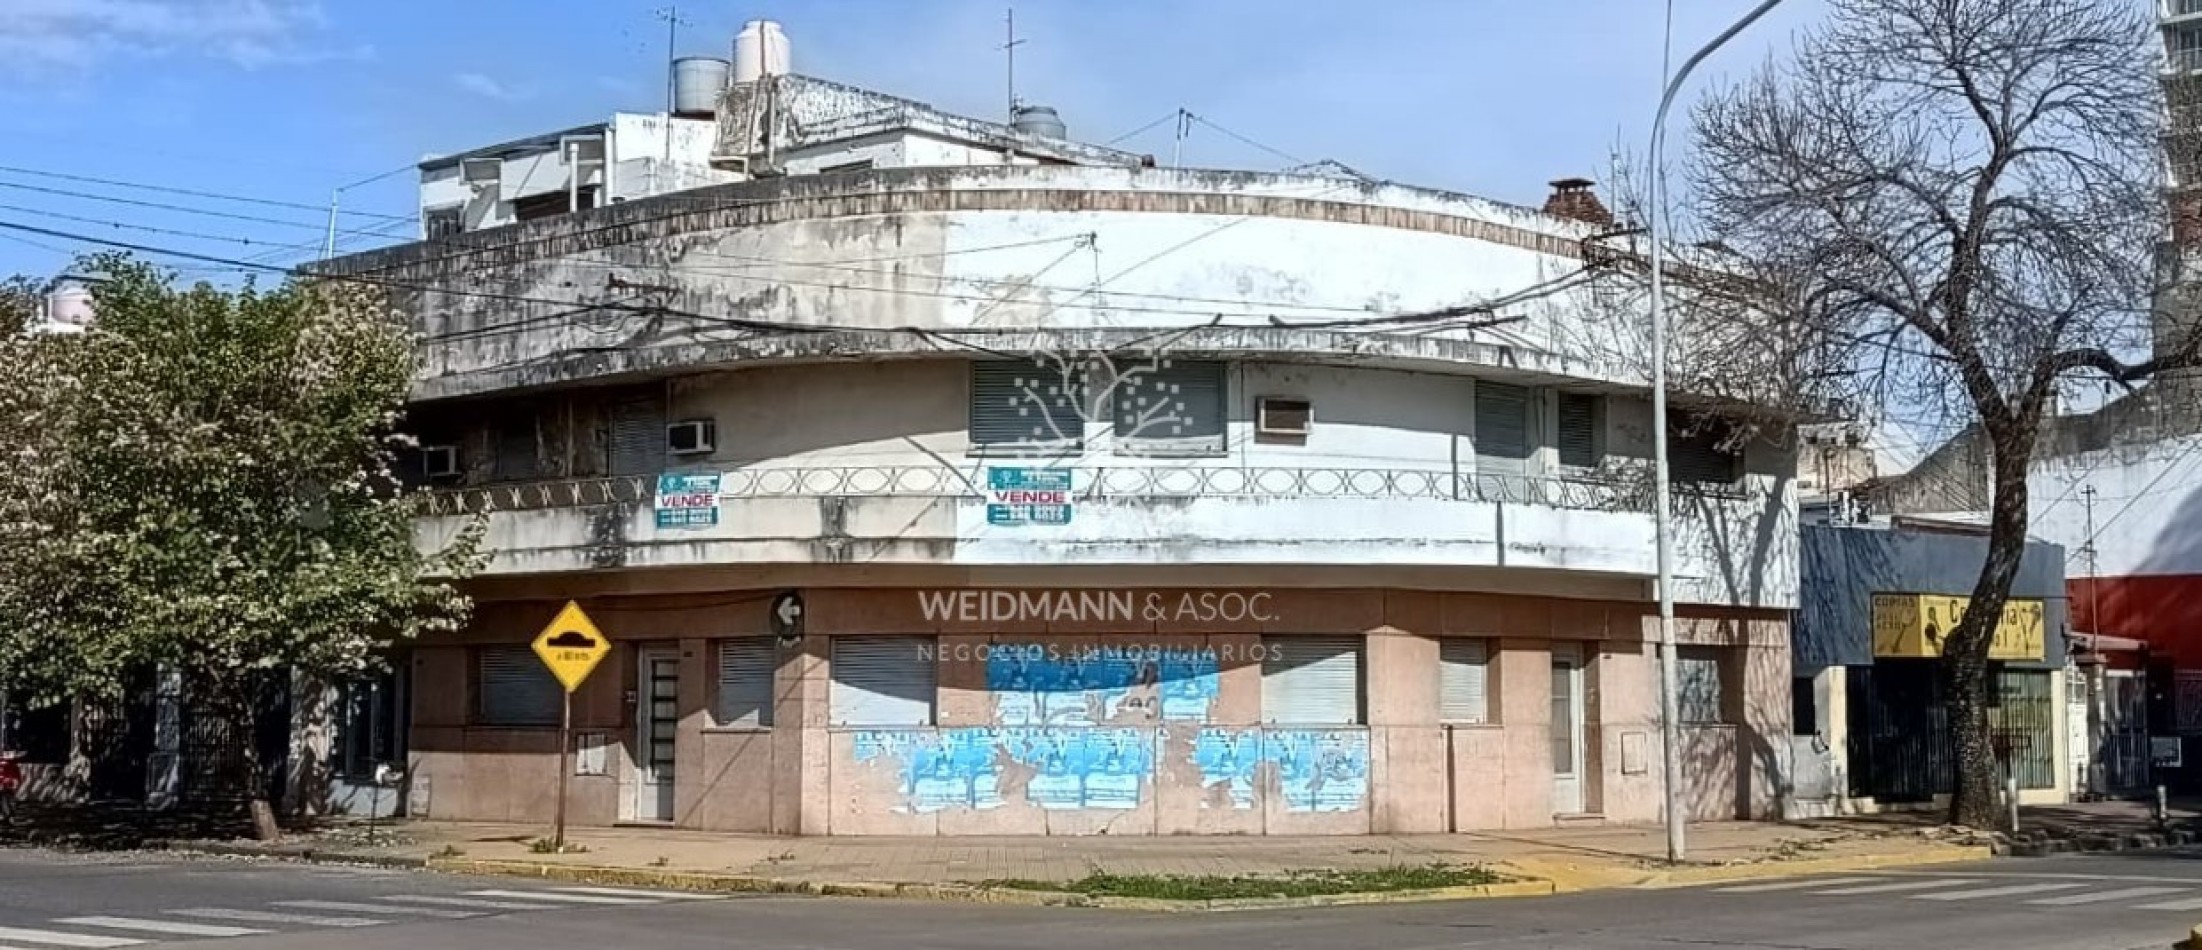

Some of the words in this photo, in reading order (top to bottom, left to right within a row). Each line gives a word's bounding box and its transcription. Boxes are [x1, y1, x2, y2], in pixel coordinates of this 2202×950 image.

[661, 495, 714, 508] VENDE
[995, 490, 1064, 503] VENDE
[1875, 597, 1914, 608] COPIAS
